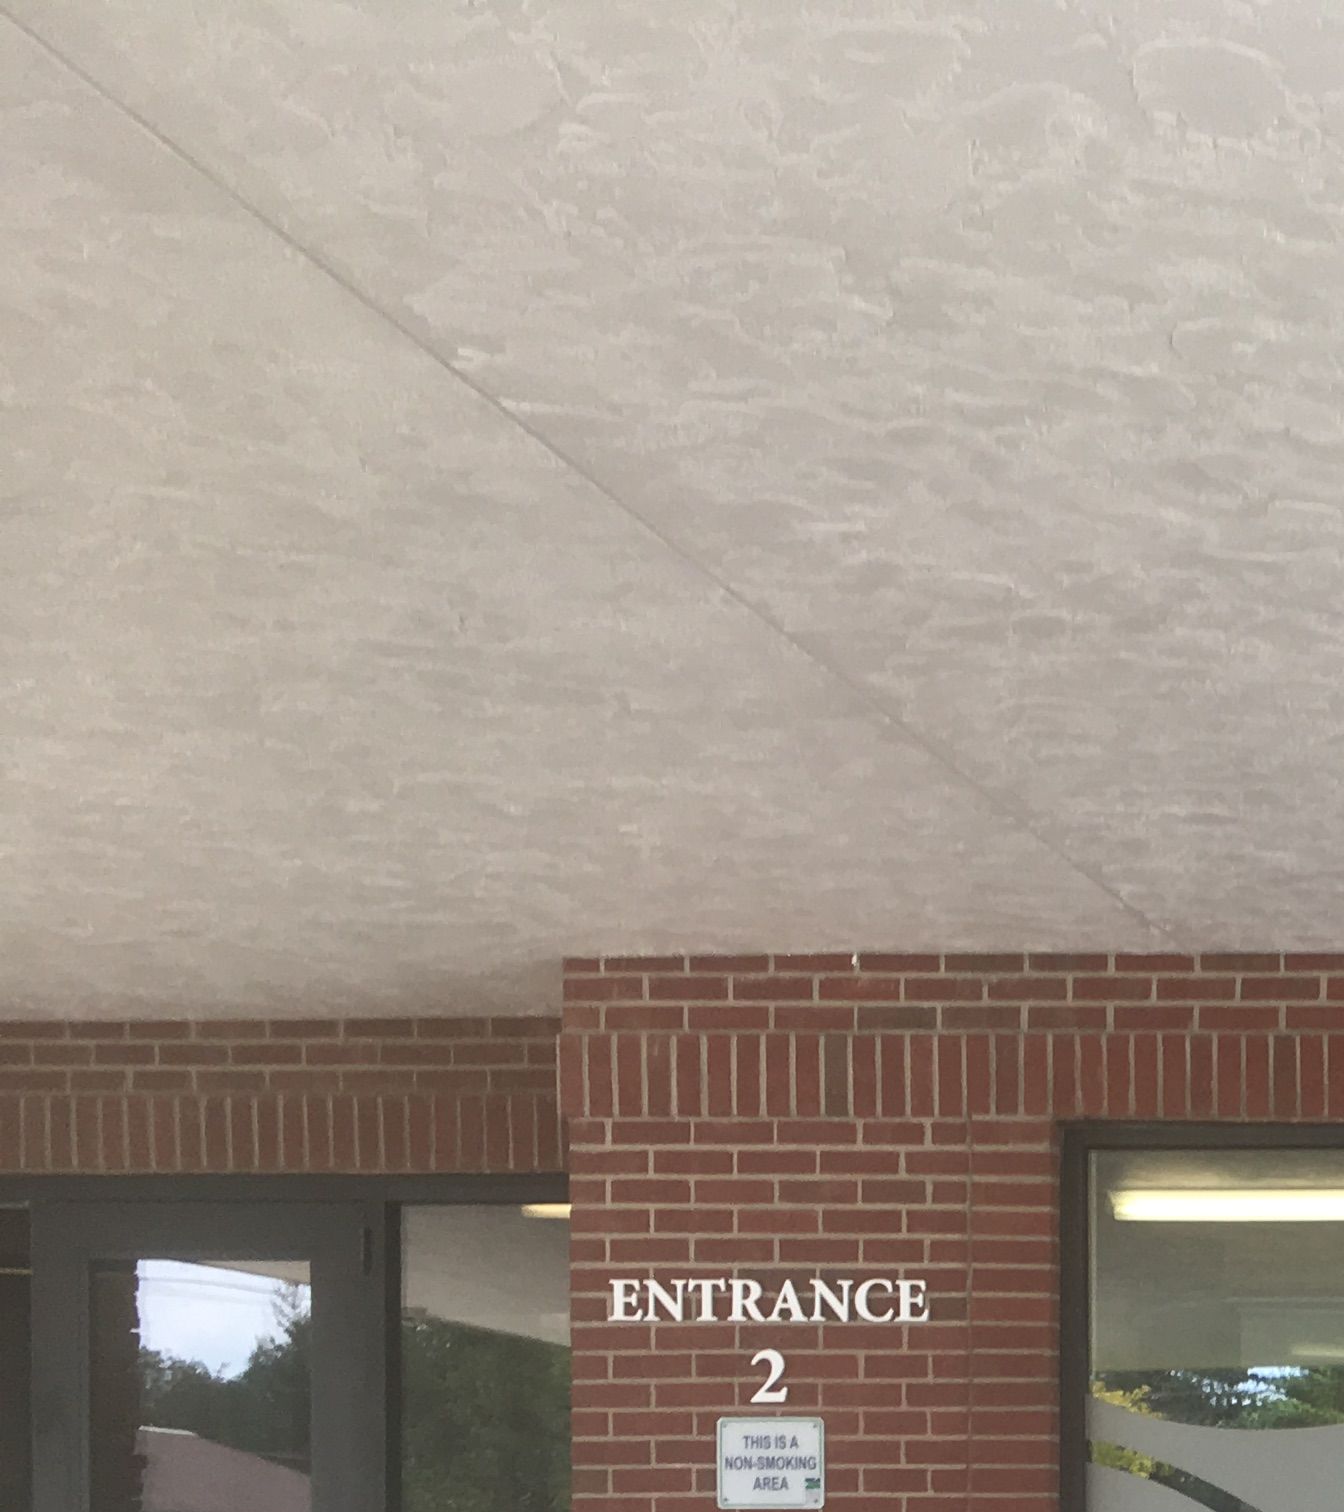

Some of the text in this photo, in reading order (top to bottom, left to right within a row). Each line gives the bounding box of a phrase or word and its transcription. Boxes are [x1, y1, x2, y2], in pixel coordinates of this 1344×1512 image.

[607, 1277, 930, 1323] ENTRANCE
[749, 1348, 789, 1404] 2
[742, 1435, 799, 1450] THIS IS A
[724, 1456, 817, 1471] NON-SMOKING
[752, 1476, 789, 1491] AREA
